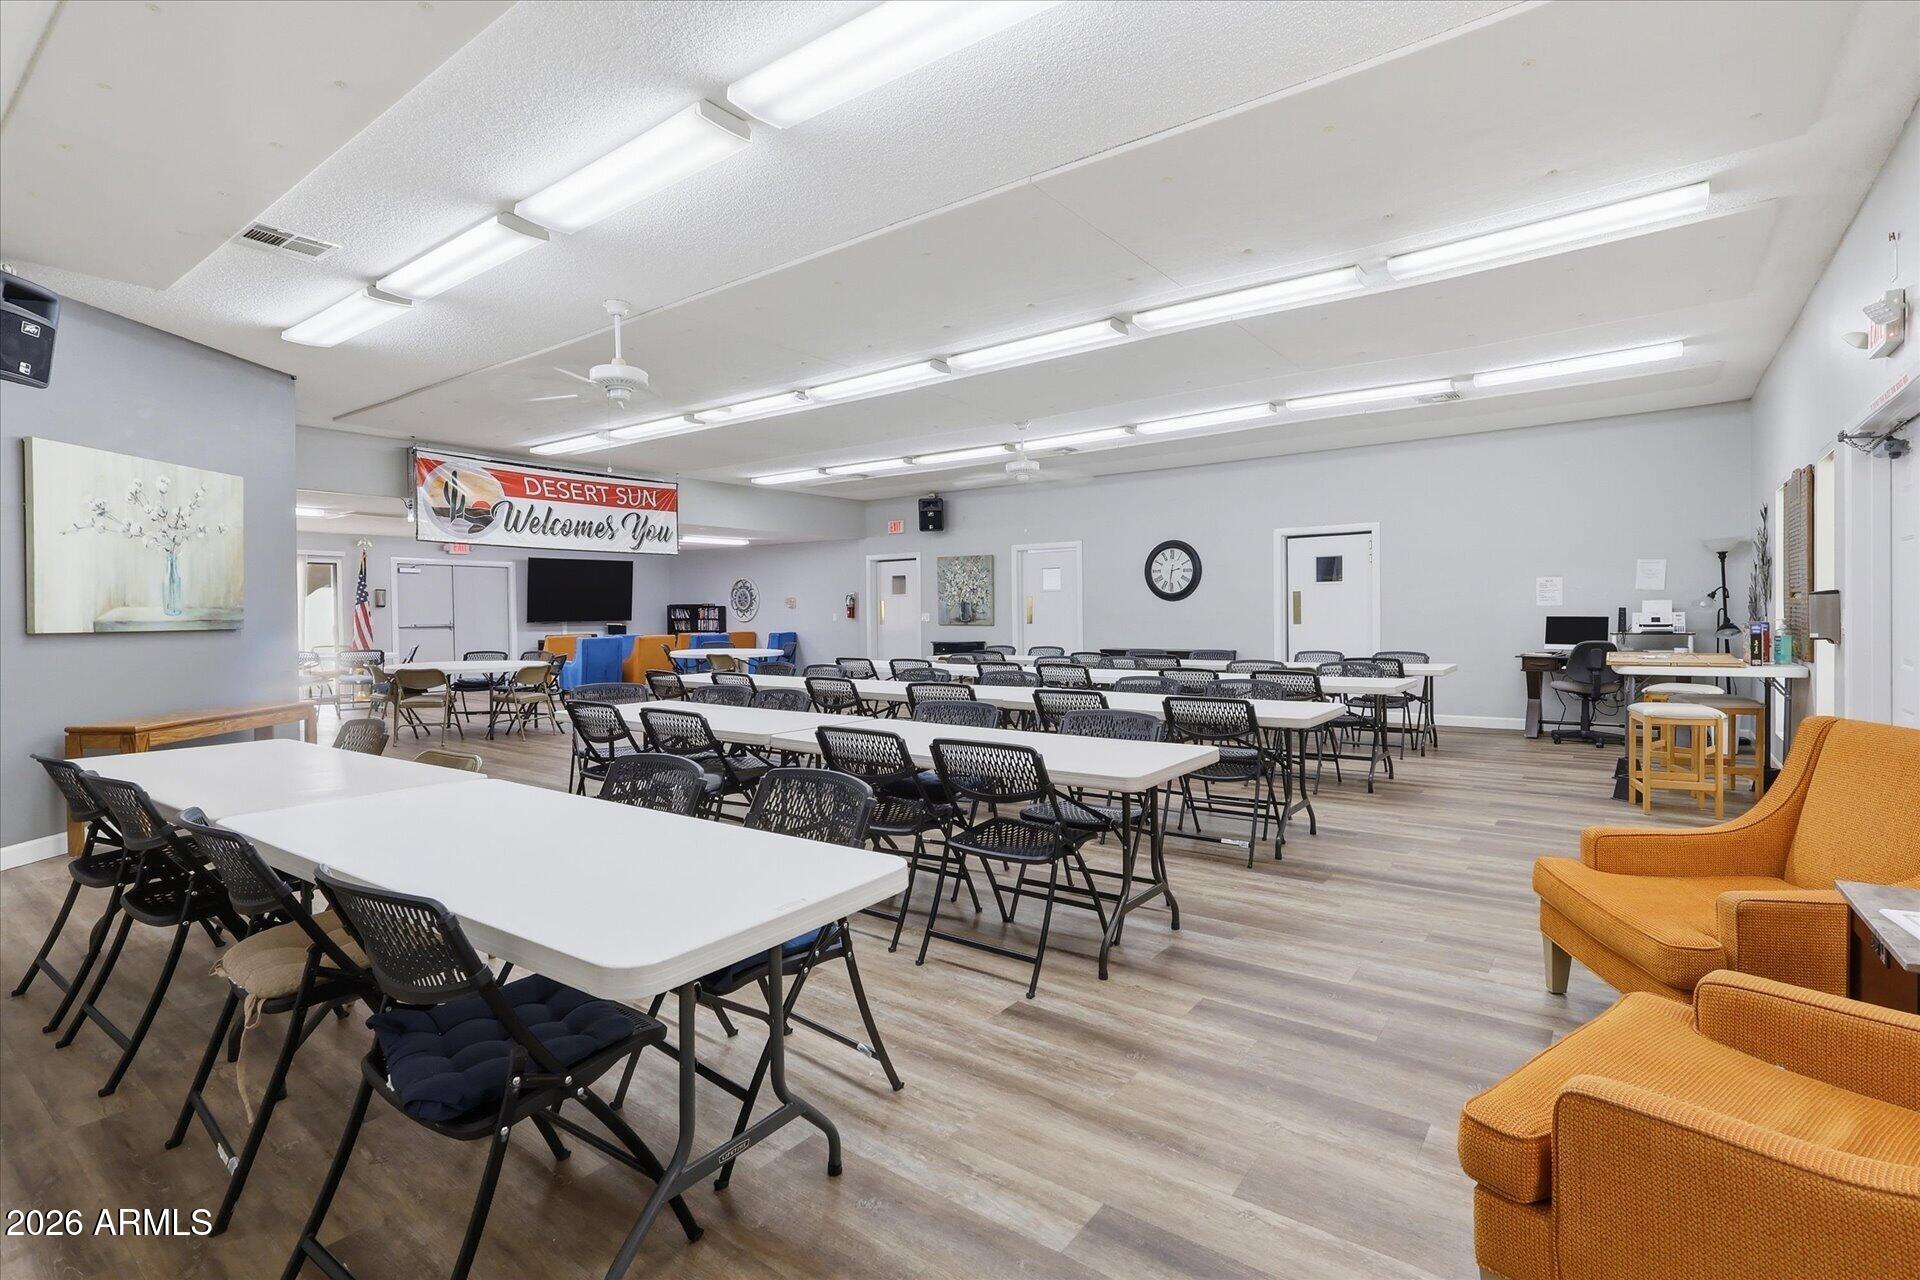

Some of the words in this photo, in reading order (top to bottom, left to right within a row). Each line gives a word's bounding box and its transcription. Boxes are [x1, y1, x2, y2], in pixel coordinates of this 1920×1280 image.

[523, 476, 609, 503] DESERT
[616, 487, 657, 508] SUN
[491, 500, 618, 541] Welcomes
[621, 512, 673, 550] You
